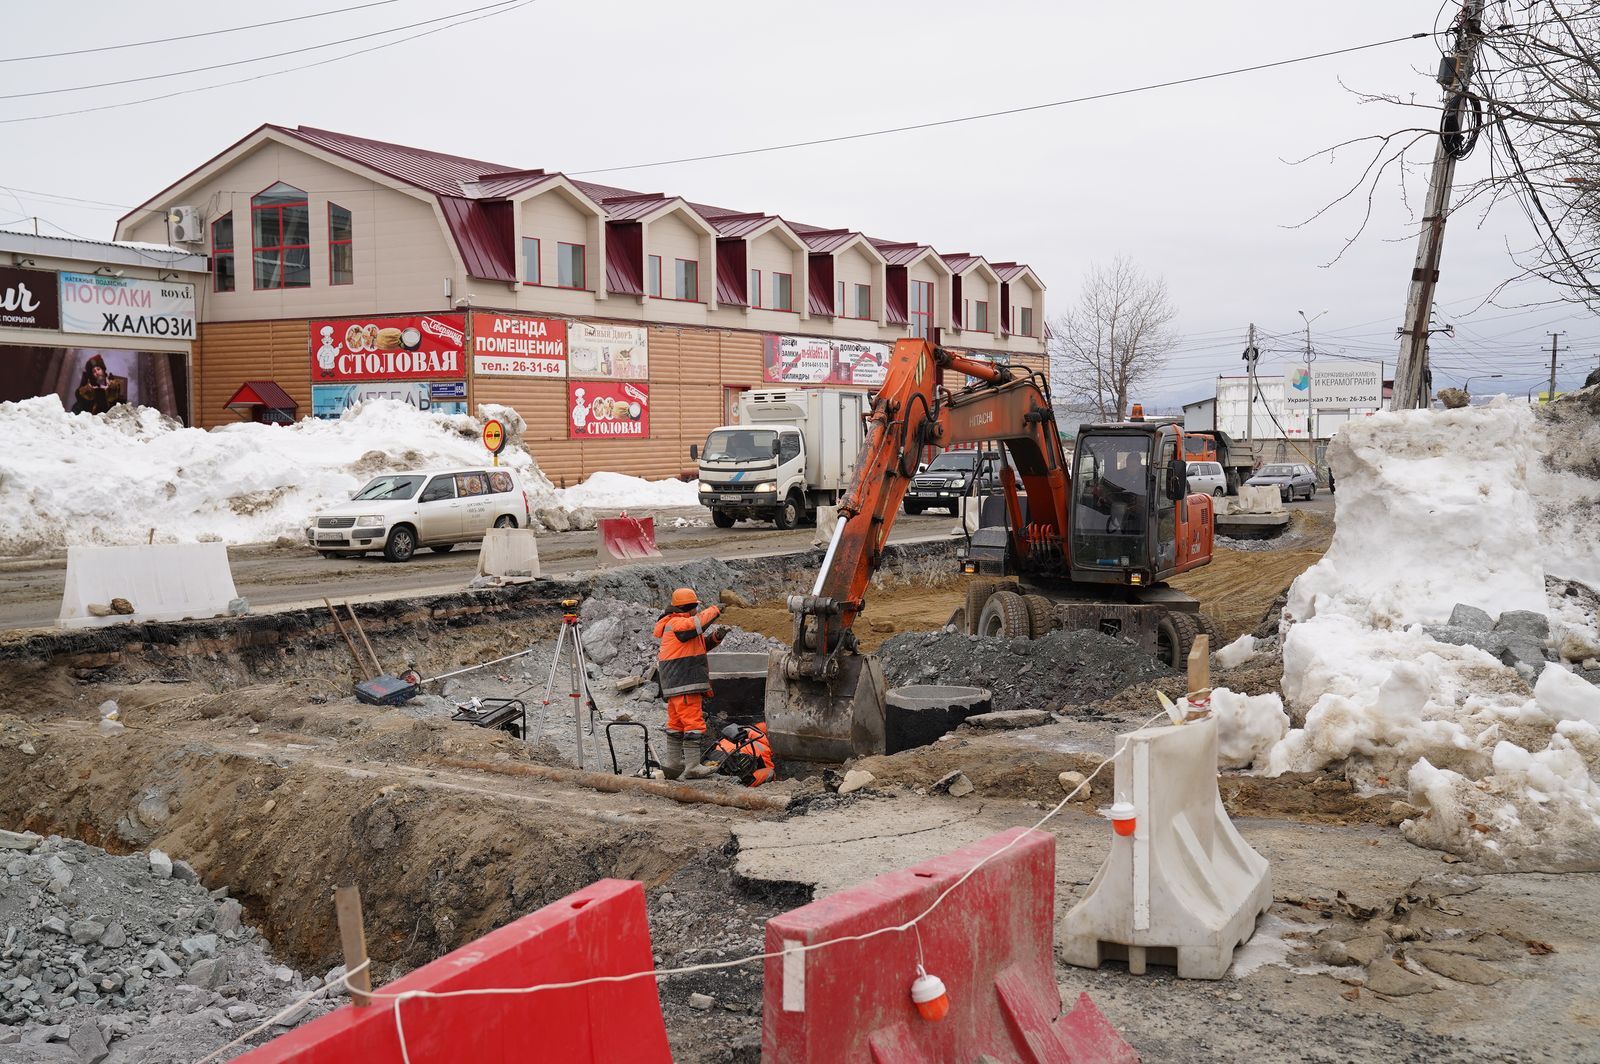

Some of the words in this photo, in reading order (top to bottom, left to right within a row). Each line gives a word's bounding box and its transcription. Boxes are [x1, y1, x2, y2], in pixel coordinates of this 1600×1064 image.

[65, 283, 151, 308] ПОТОЛКИ
[161, 288, 192, 299] ROYAL
[2, 315, 36, 324] ПОКРЫТИЙ
[102, 312, 192, 336] ЖАЛЮЗИ
[493, 318, 547, 338] АРЕНДА
[476, 336, 563, 356] ПОМЕЩЕНИЙ
[338, 350, 458, 374] СТОЛОВАЯ
[481, 361, 509, 371] тел.:
[512, 361, 560, 374] 26-31-64
[1314, 370, 1355, 379] ДЕКОРАТИВНЫЙ
[1356, 370, 1377, 378] КАМЕНЬ
[1314, 379, 1321, 387] И
[1322, 377, 1377, 387] КЕРАМОГРАНИТ
[968, 411, 993, 428] HITACHI
[587, 421, 642, 435] СТОЛОВАЯ
